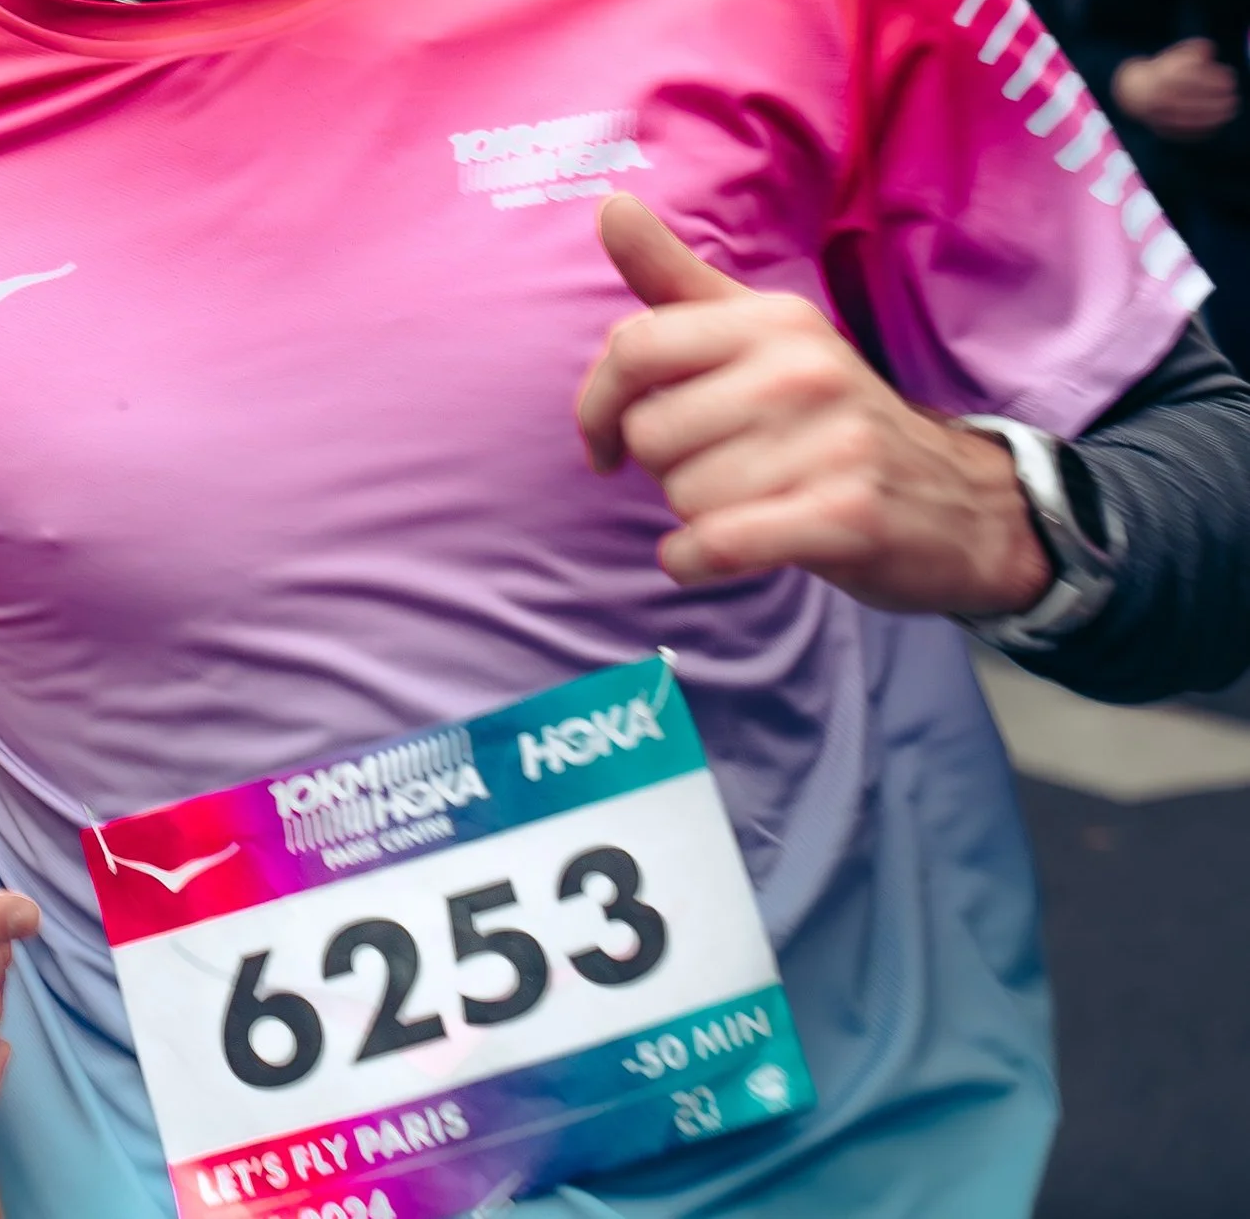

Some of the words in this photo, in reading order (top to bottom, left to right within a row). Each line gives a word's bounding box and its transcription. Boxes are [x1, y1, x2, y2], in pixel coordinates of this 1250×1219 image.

[517, 698, 666, 782] HOKA
[370, 763, 490, 830] HOKA
[221, 844, 668, 1090] 6253
[691, 1004, 773, 1061] MIN
[195, 1150, 290, 1207] LET'S
[287, 1132, 349, 1181] FLY
[352, 1099, 470, 1165] PARIS
